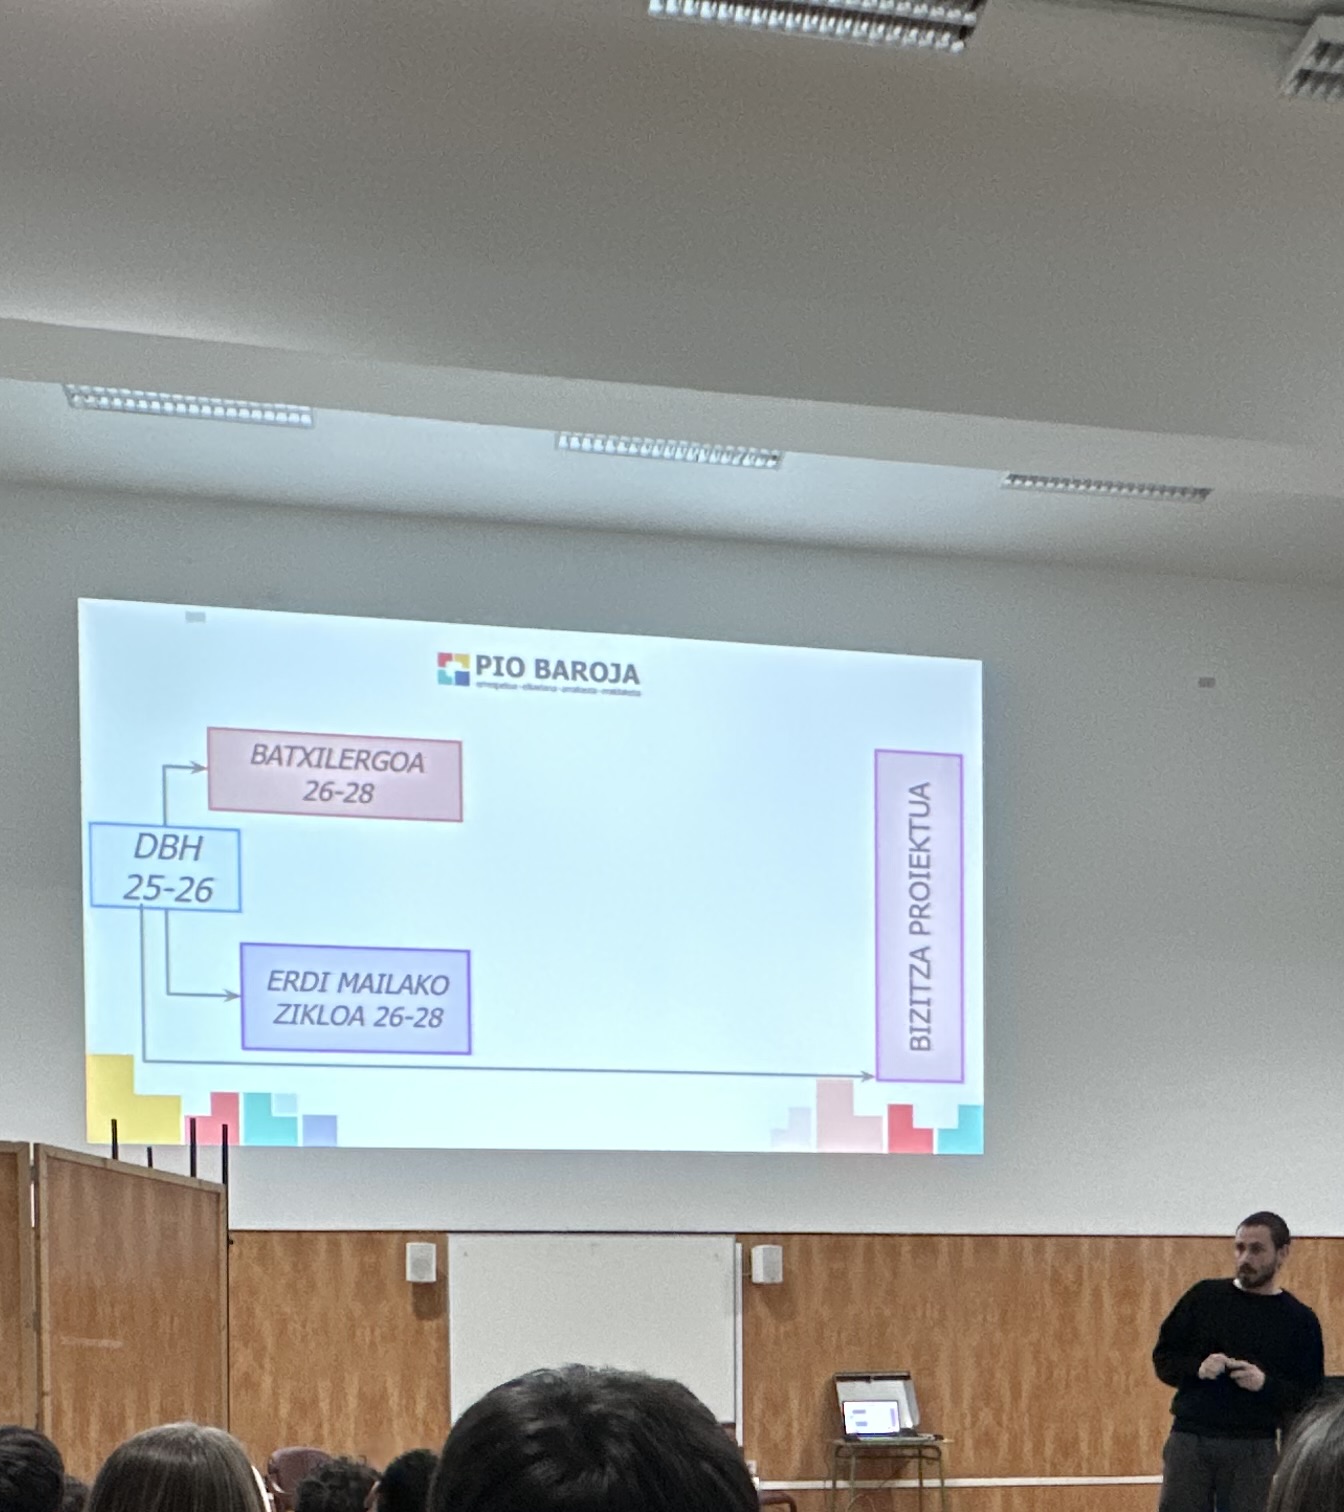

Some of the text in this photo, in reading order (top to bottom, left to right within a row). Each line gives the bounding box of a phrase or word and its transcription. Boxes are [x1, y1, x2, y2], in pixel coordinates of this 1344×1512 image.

[476, 654, 640, 684] PIO BAROJA
[250, 743, 425, 773] BATXILERGOA
[303, 780, 375, 804] 26-28
[134, 832, 204, 861] DBH
[123, 873, 215, 903] 25-26
[909, 781, 931, 1052] BIZITZA PROIEKTUA
[267, 970, 450, 996] ERDI MAILAKO
[273, 1003, 444, 1028] ZIKLOA 26-28
